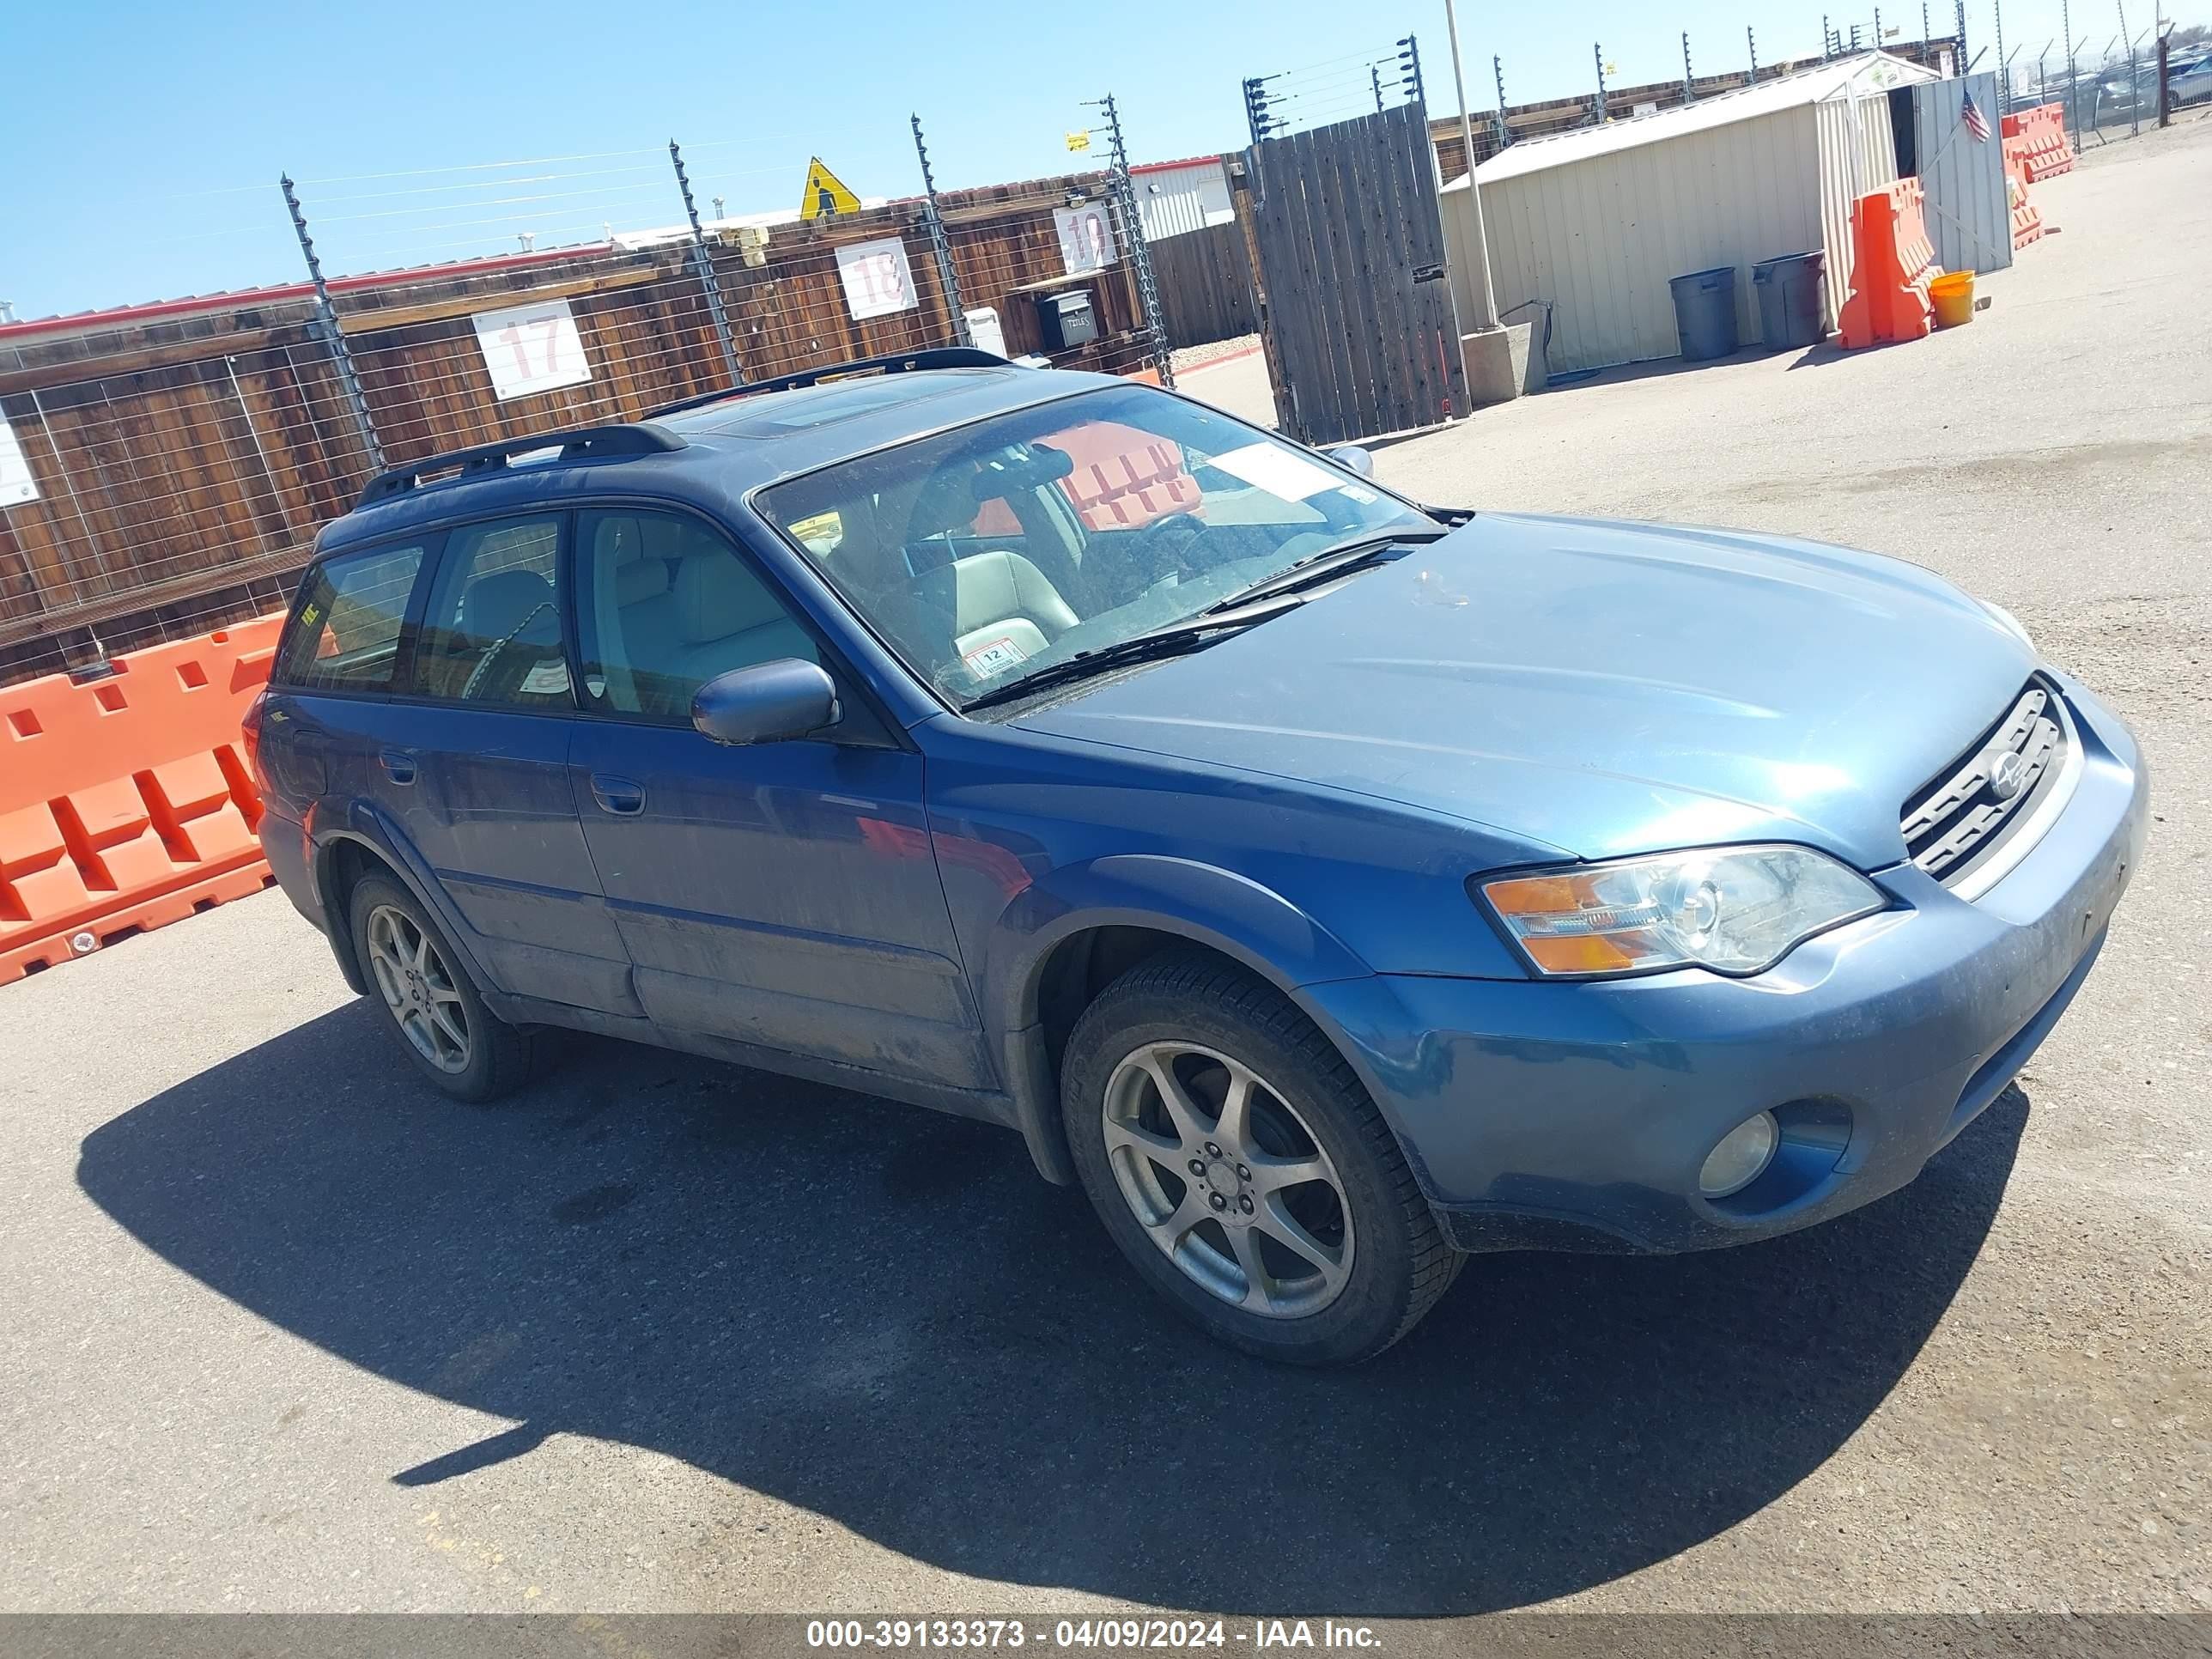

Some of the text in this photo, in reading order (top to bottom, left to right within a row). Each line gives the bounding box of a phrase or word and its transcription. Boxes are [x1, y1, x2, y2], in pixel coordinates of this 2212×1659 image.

[854, 252, 902, 304] 18
[1066, 316, 1091, 329] TITLES
[499, 314, 558, 379] 17
[983, 650, 1001, 661] 12
